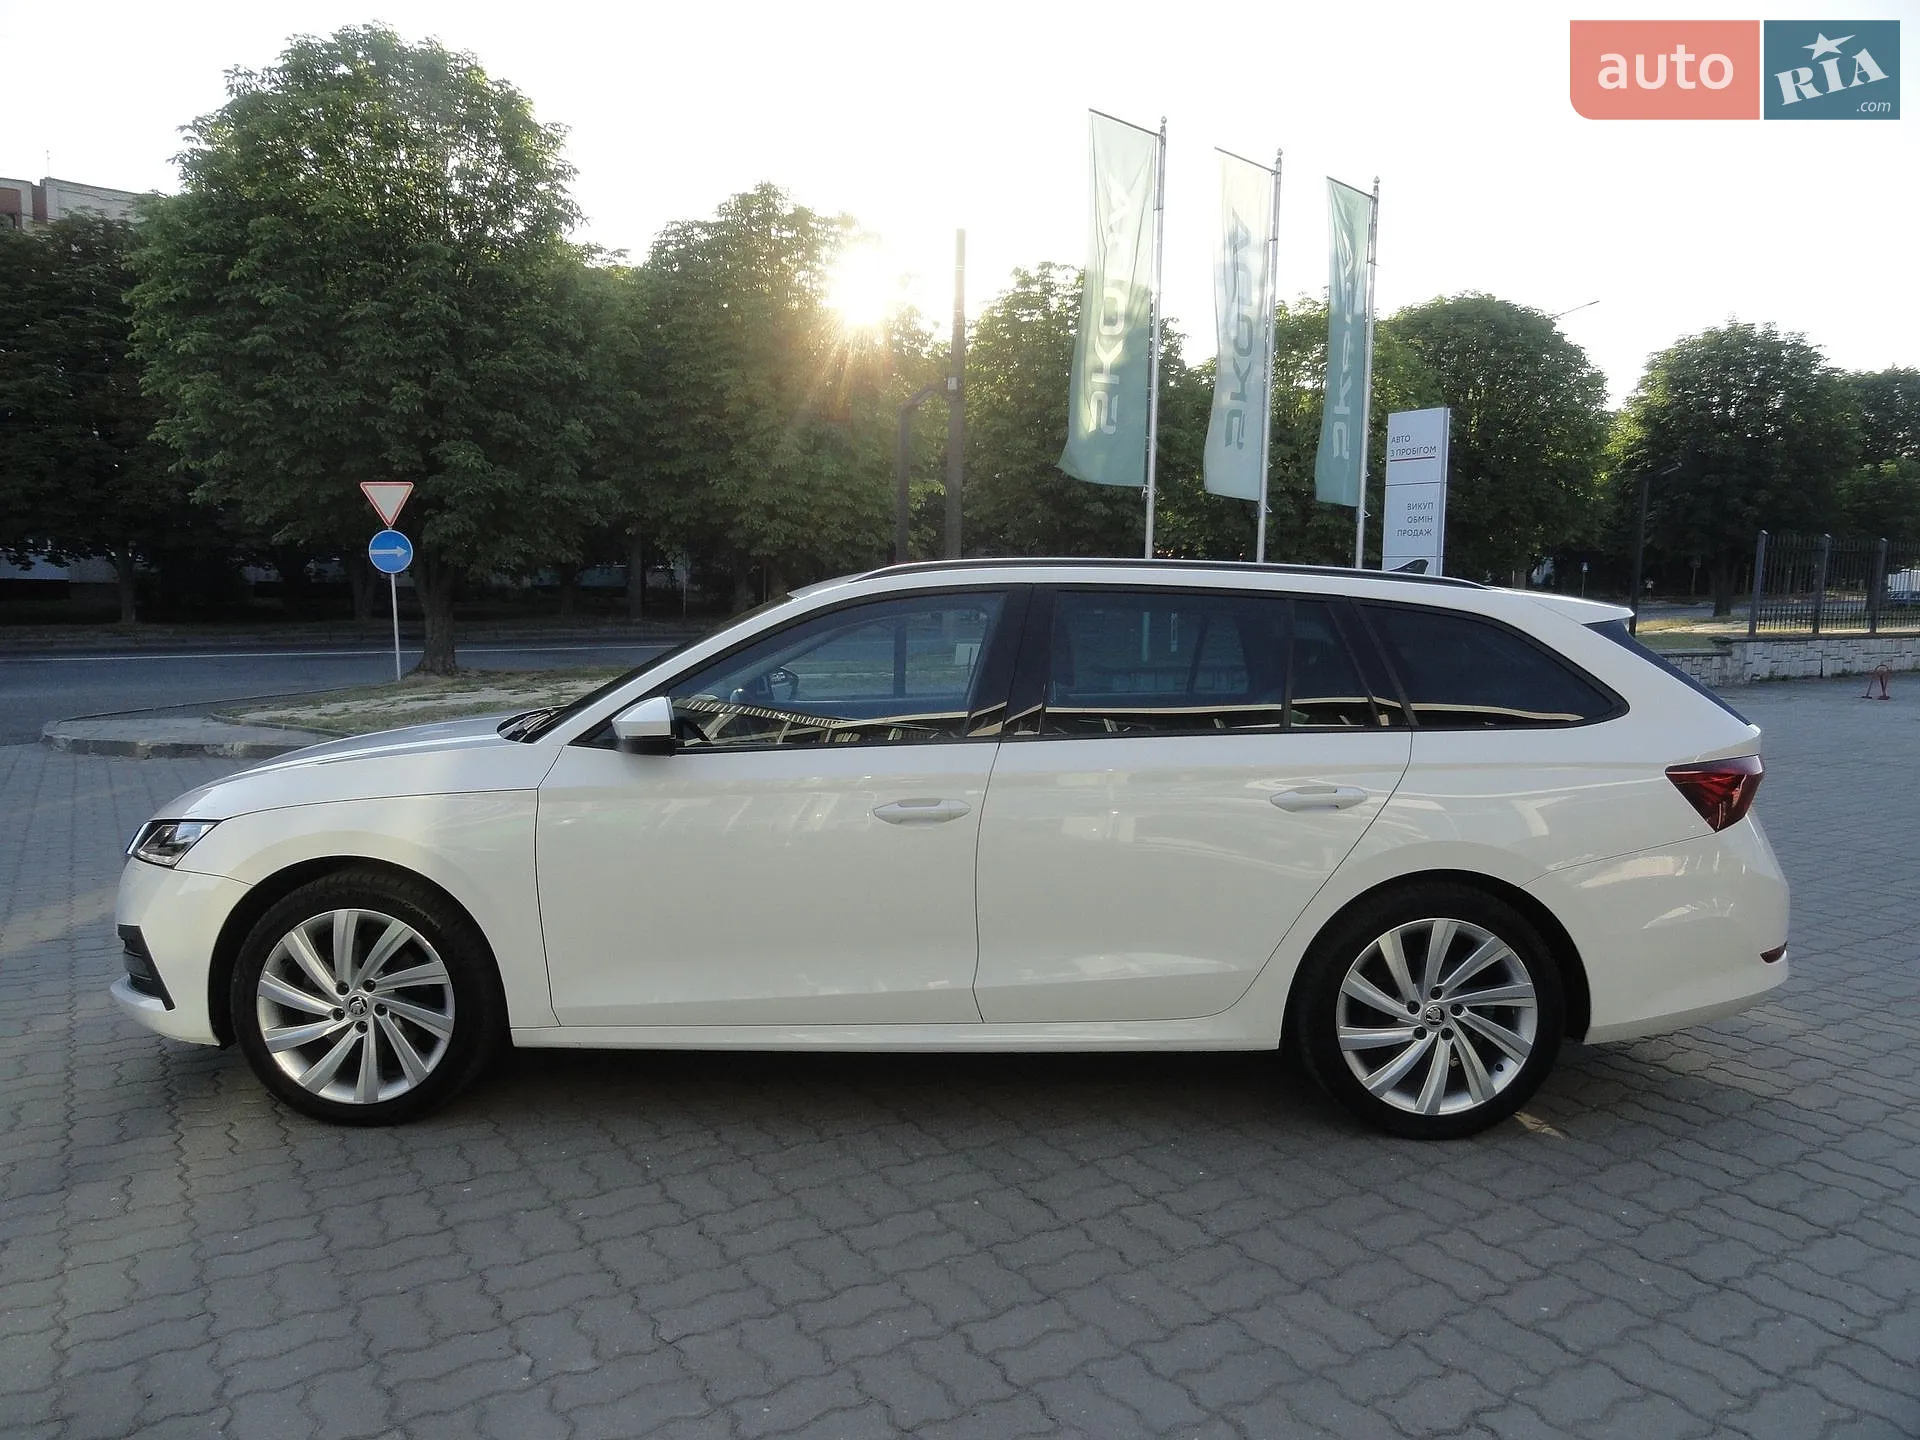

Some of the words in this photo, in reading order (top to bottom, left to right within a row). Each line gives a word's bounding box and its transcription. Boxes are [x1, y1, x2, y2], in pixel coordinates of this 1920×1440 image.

[1391, 435, 1411, 444] АВТО
[1396, 446, 1437, 456] ПРОБІГОМ
[1407, 502, 1434, 511] ВИКУП
[1407, 515, 1433, 524] ОБМІН
[1396, 529, 1433, 537] ПРОДАЖ
